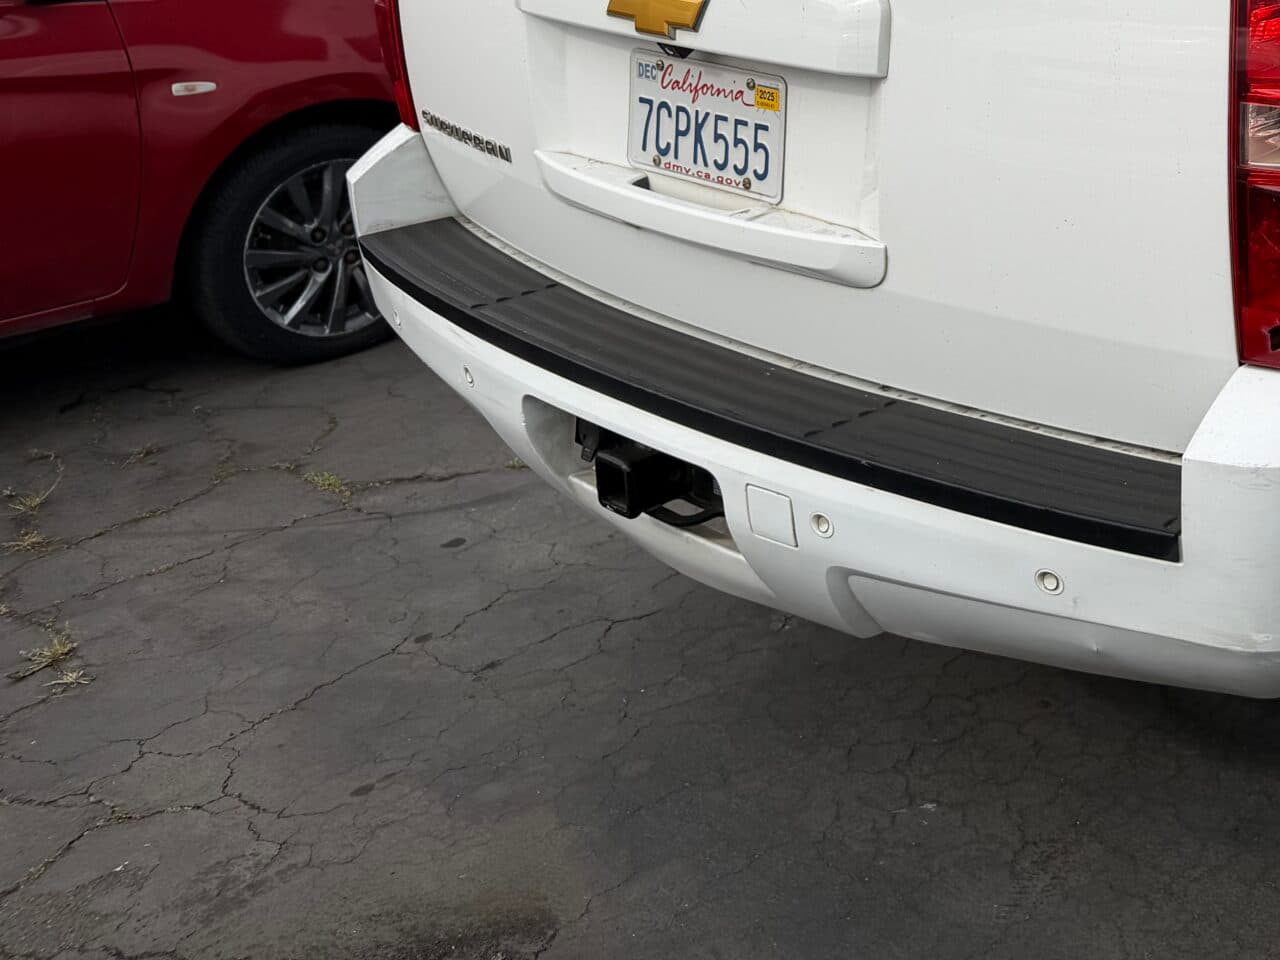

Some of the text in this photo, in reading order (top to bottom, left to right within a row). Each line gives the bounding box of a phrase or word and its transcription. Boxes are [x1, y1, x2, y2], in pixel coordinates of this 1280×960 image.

[638, 61, 657, 81] DEC
[660, 63, 755, 107] California
[759, 89, 776, 102] 2025
[638, 96, 770, 182] 7CPK555
[663, 161, 742, 187] dmv.ca.gov
